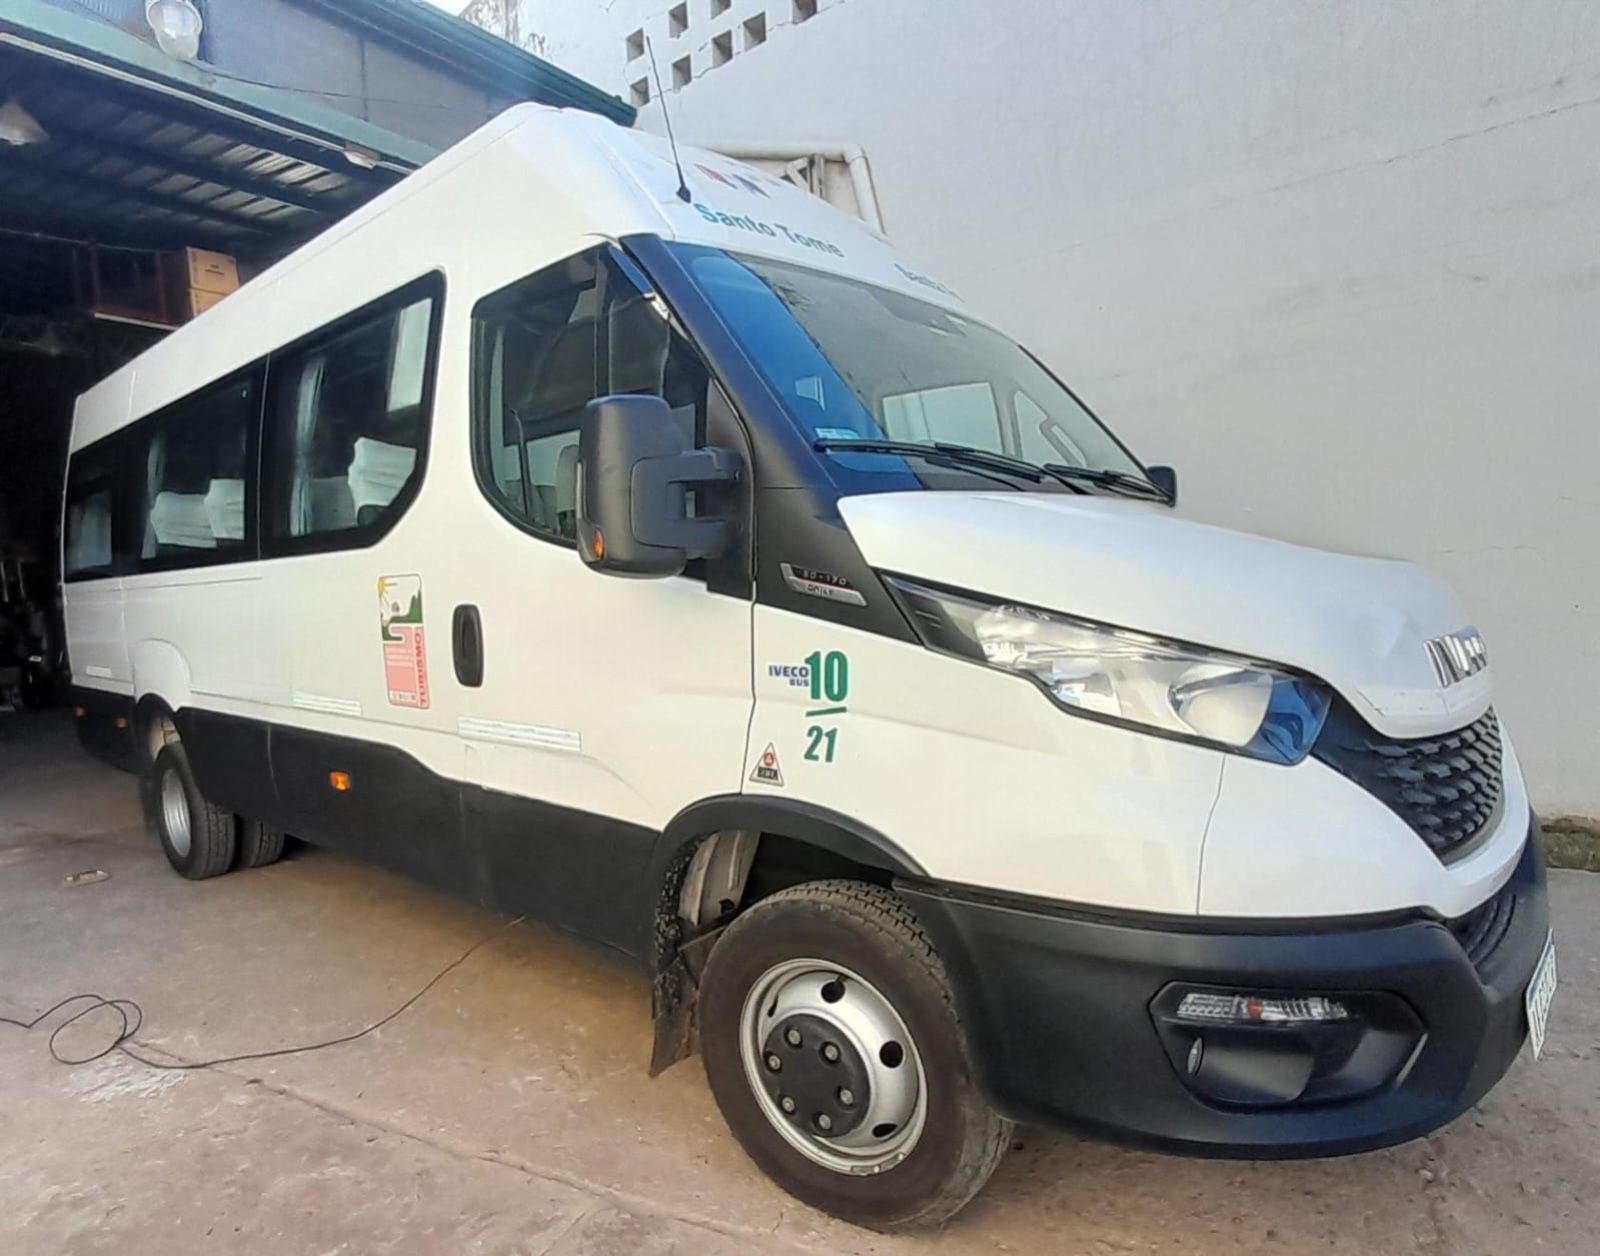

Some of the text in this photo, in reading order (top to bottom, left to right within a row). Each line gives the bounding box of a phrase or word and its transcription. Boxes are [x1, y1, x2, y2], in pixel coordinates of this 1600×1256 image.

[693, 202, 776, 238] Santo
[415, 632, 427, 706] TURISMO
[768, 664, 809, 678] IVECO
[789, 678, 809, 688] BUS
[804, 650, 849, 702] 10
[803, 724, 838, 763] 21
